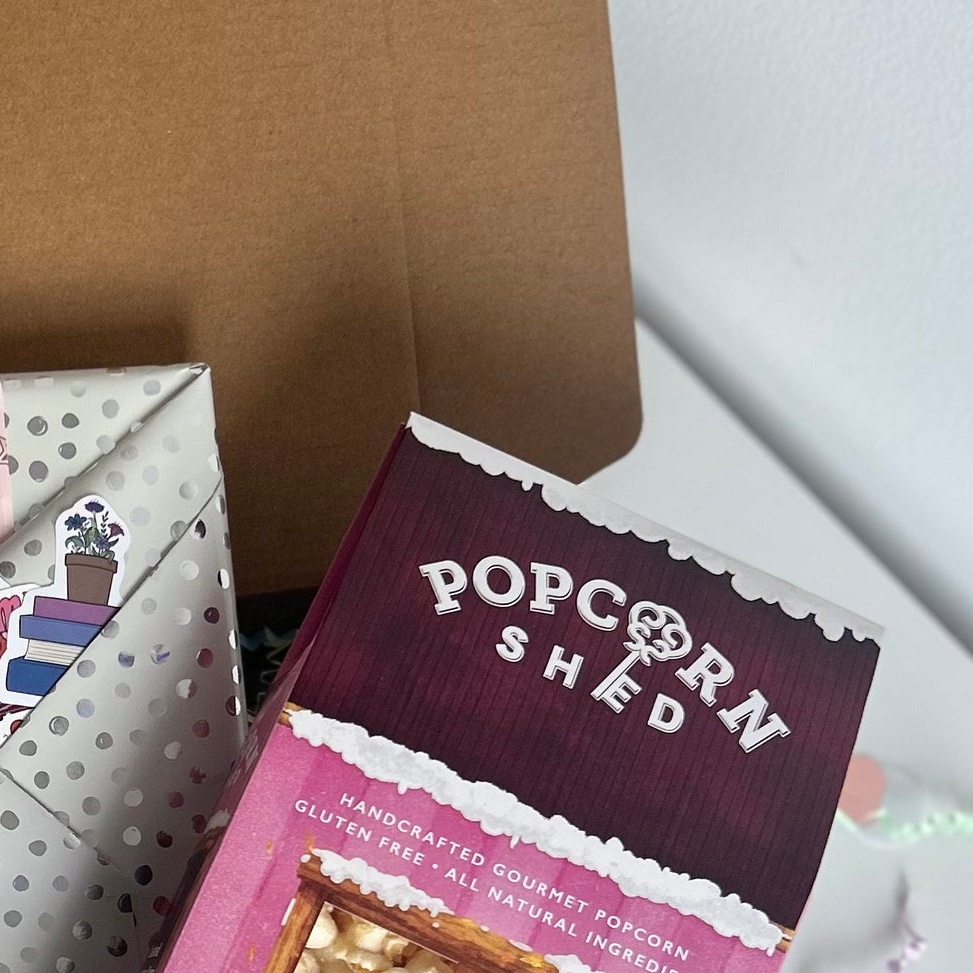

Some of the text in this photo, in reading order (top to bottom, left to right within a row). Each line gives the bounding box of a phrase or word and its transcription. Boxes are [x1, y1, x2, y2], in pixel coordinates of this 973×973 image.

[418, 555, 791, 753] POPCORN
[495, 625, 686, 735] SHED
[293, 799, 373, 844] GLUTEN
[378, 835, 426, 868] FREE
[443, 865, 479, 894] ALL
[487, 885, 579, 938] NATURAL
[339, 791, 691, 963] HANDCRAFTED GOURMET POPCORN
